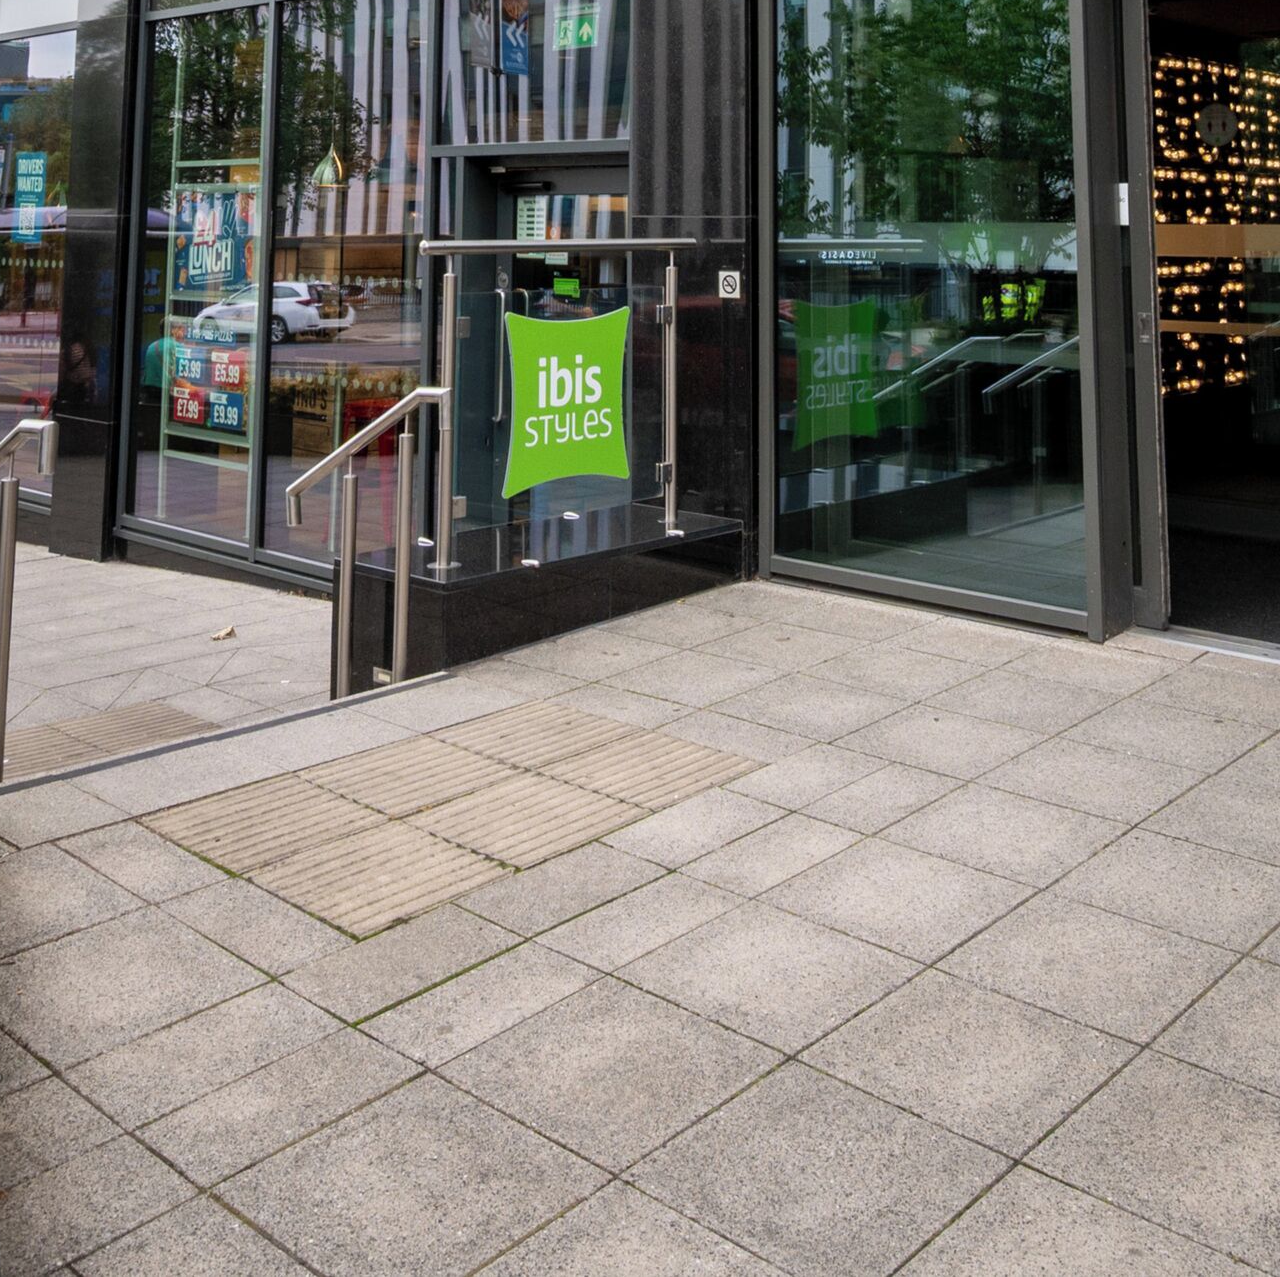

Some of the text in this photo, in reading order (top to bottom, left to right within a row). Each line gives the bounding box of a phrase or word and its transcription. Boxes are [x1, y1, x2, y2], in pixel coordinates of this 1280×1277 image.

[18, 159, 44, 175] DRIVERS
[17, 176, 43, 192] WANTED
[189, 240, 233, 275] LUNCH
[178, 358, 201, 379] £3.99
[215, 363, 240, 384] £5.99
[538, 354, 602, 409] ibis
[177, 398, 199, 419] £7.99
[296, 389, 328, 410] INO'S
[213, 404, 239, 426] £9.99
